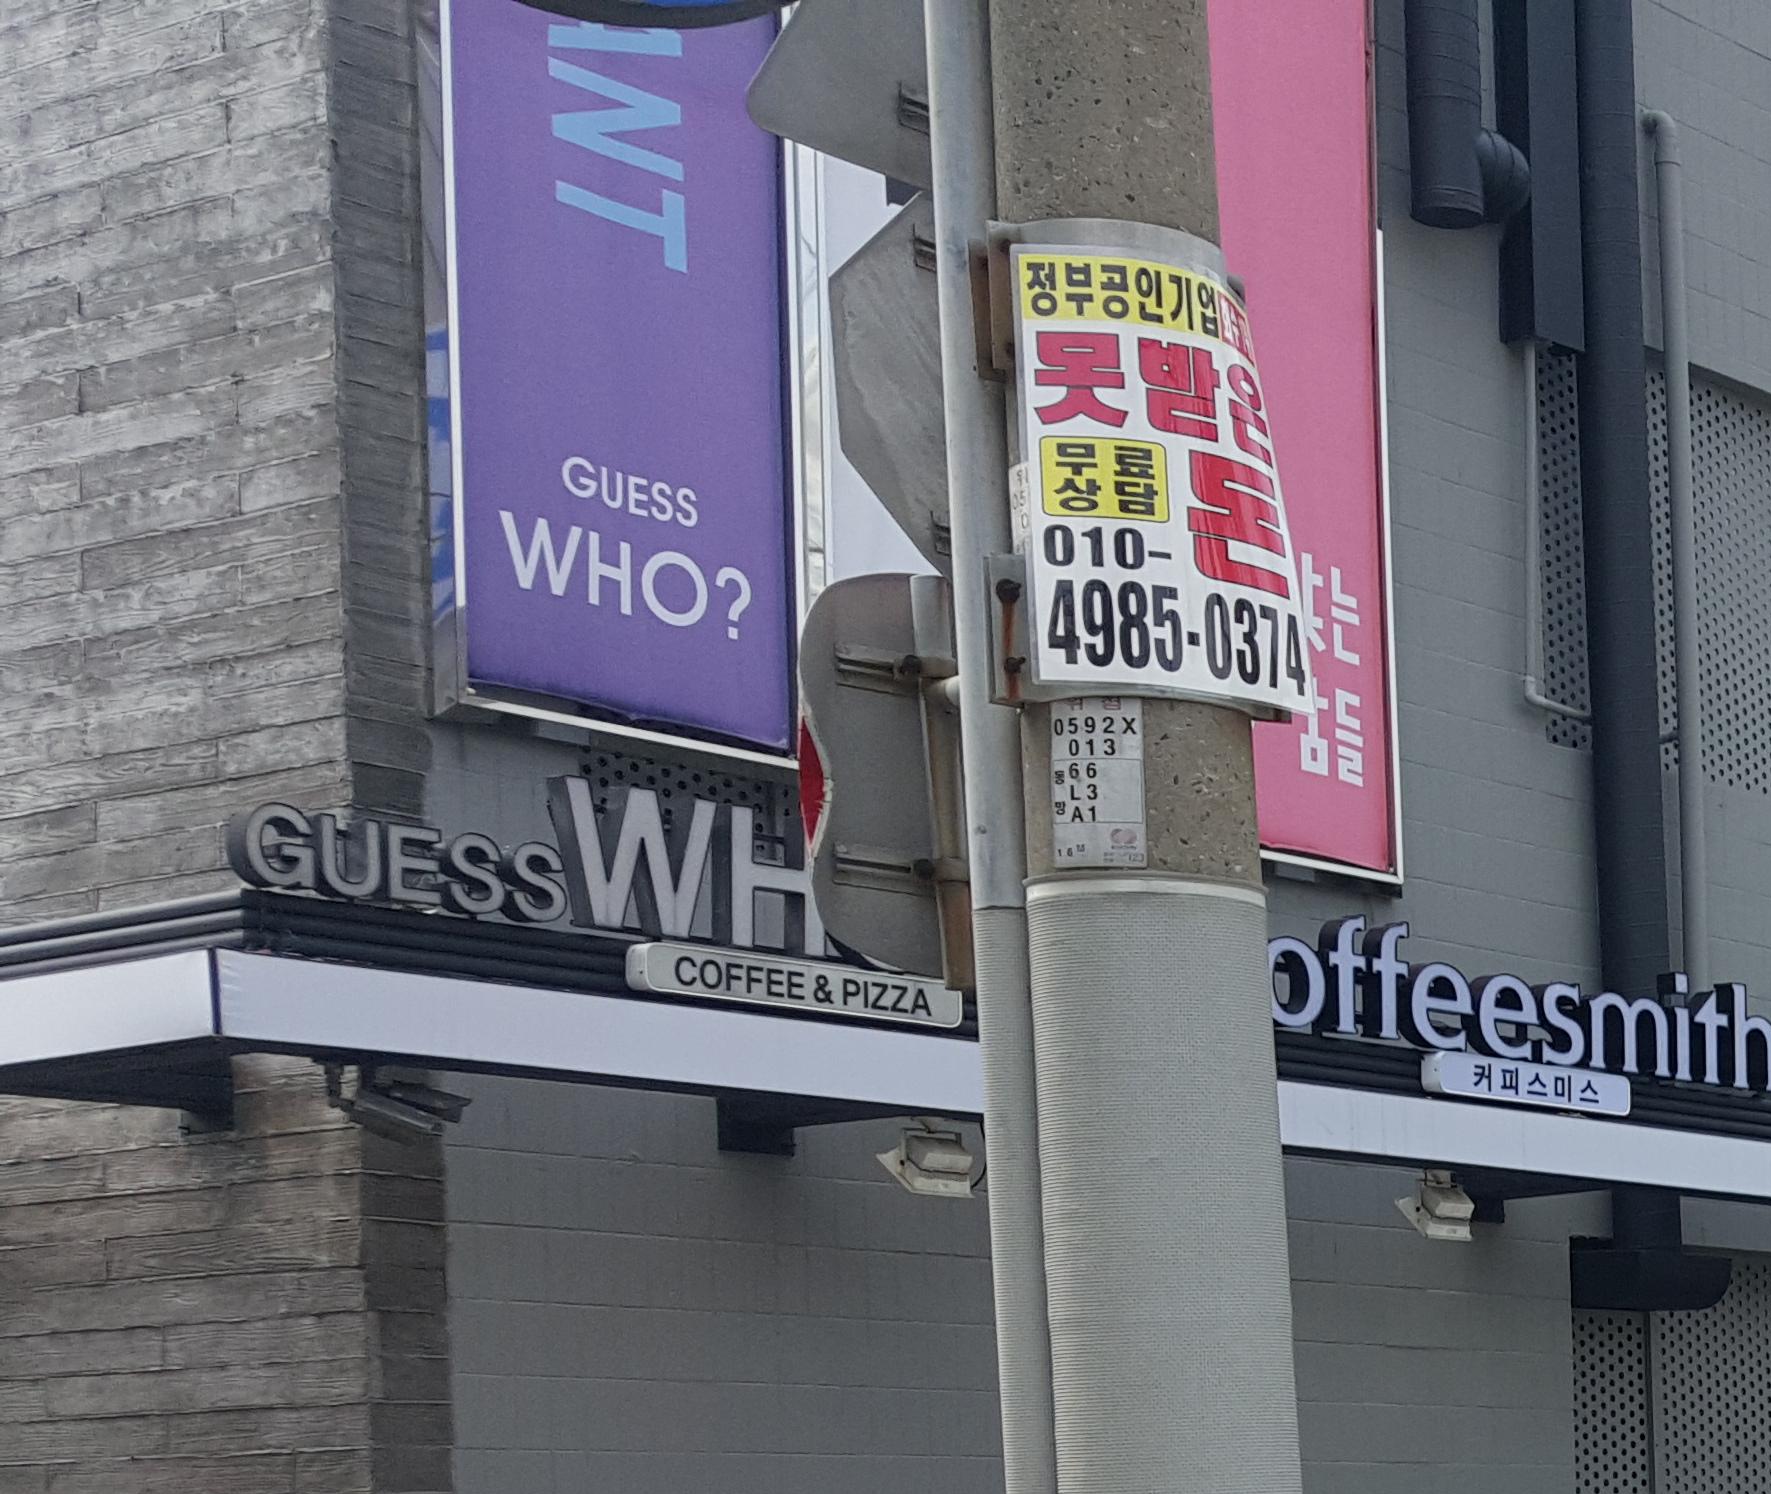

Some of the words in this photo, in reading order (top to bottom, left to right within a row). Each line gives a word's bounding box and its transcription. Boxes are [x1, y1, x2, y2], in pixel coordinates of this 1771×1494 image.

[1026, 261, 1220, 339] 정부공인기업
[1055, 442, 1155, 480] 무료
[561, 456, 699, 528] GUESS
[1053, 477, 1159, 516] 상담
[1043, 524, 1172, 570] 010-
[1186, 448, 1290, 600] 돈
[498, 509, 752, 640] WHO?
[1048, 578, 1306, 697] 4985-0374
[1068, 739, 1117, 757] 013
[1068, 762, 1098, 780] 66
[1069, 783, 1099, 801] L3
[1071, 805, 1097, 823] A1
[231, 802, 568, 922] GUESS
[675, 955, 805, 1002] COFFEE
[812, 977, 833, 1006] &
[841, 979, 931, 1017] PIZZA
[1473, 1063, 1600, 1104] 커피스미스
